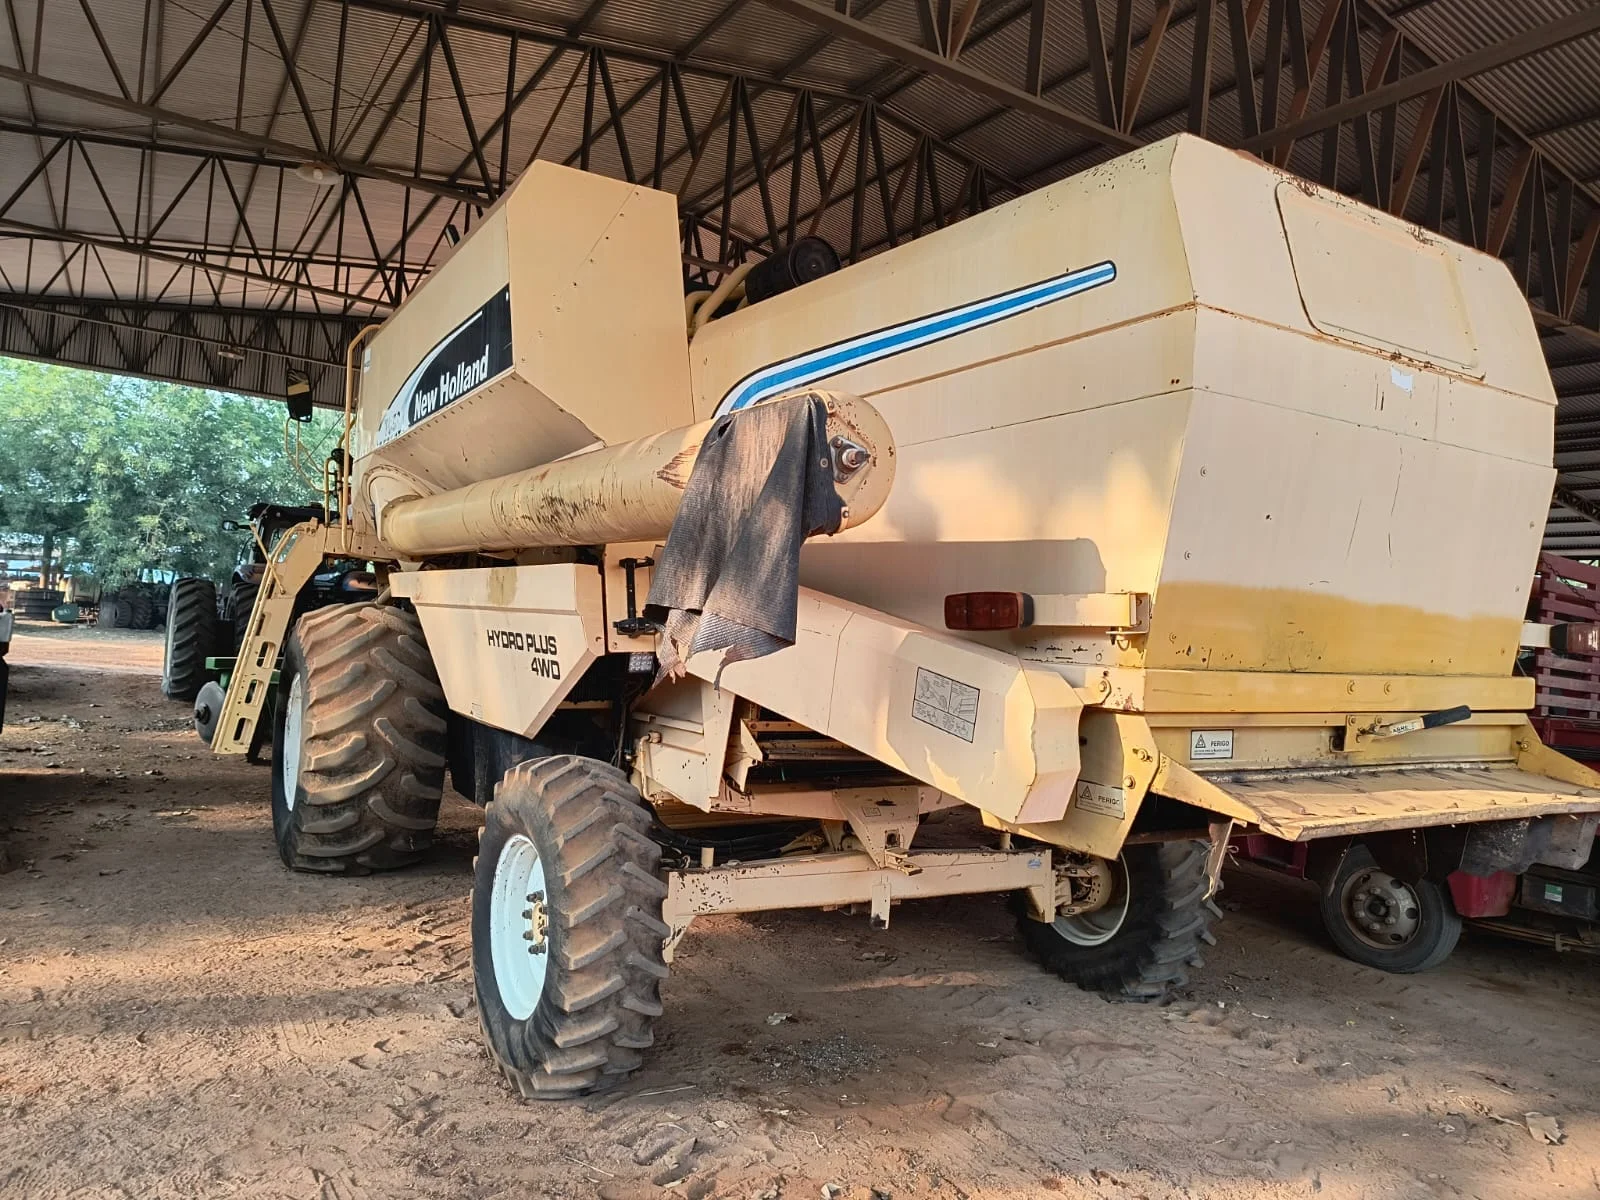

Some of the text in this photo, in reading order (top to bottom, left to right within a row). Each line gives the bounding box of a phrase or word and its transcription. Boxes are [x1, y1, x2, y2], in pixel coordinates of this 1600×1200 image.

[413, 344, 489, 421] New Holland
[487, 629, 557, 655] HYDRO PLUS
[531, 657, 560, 680] 4WD
